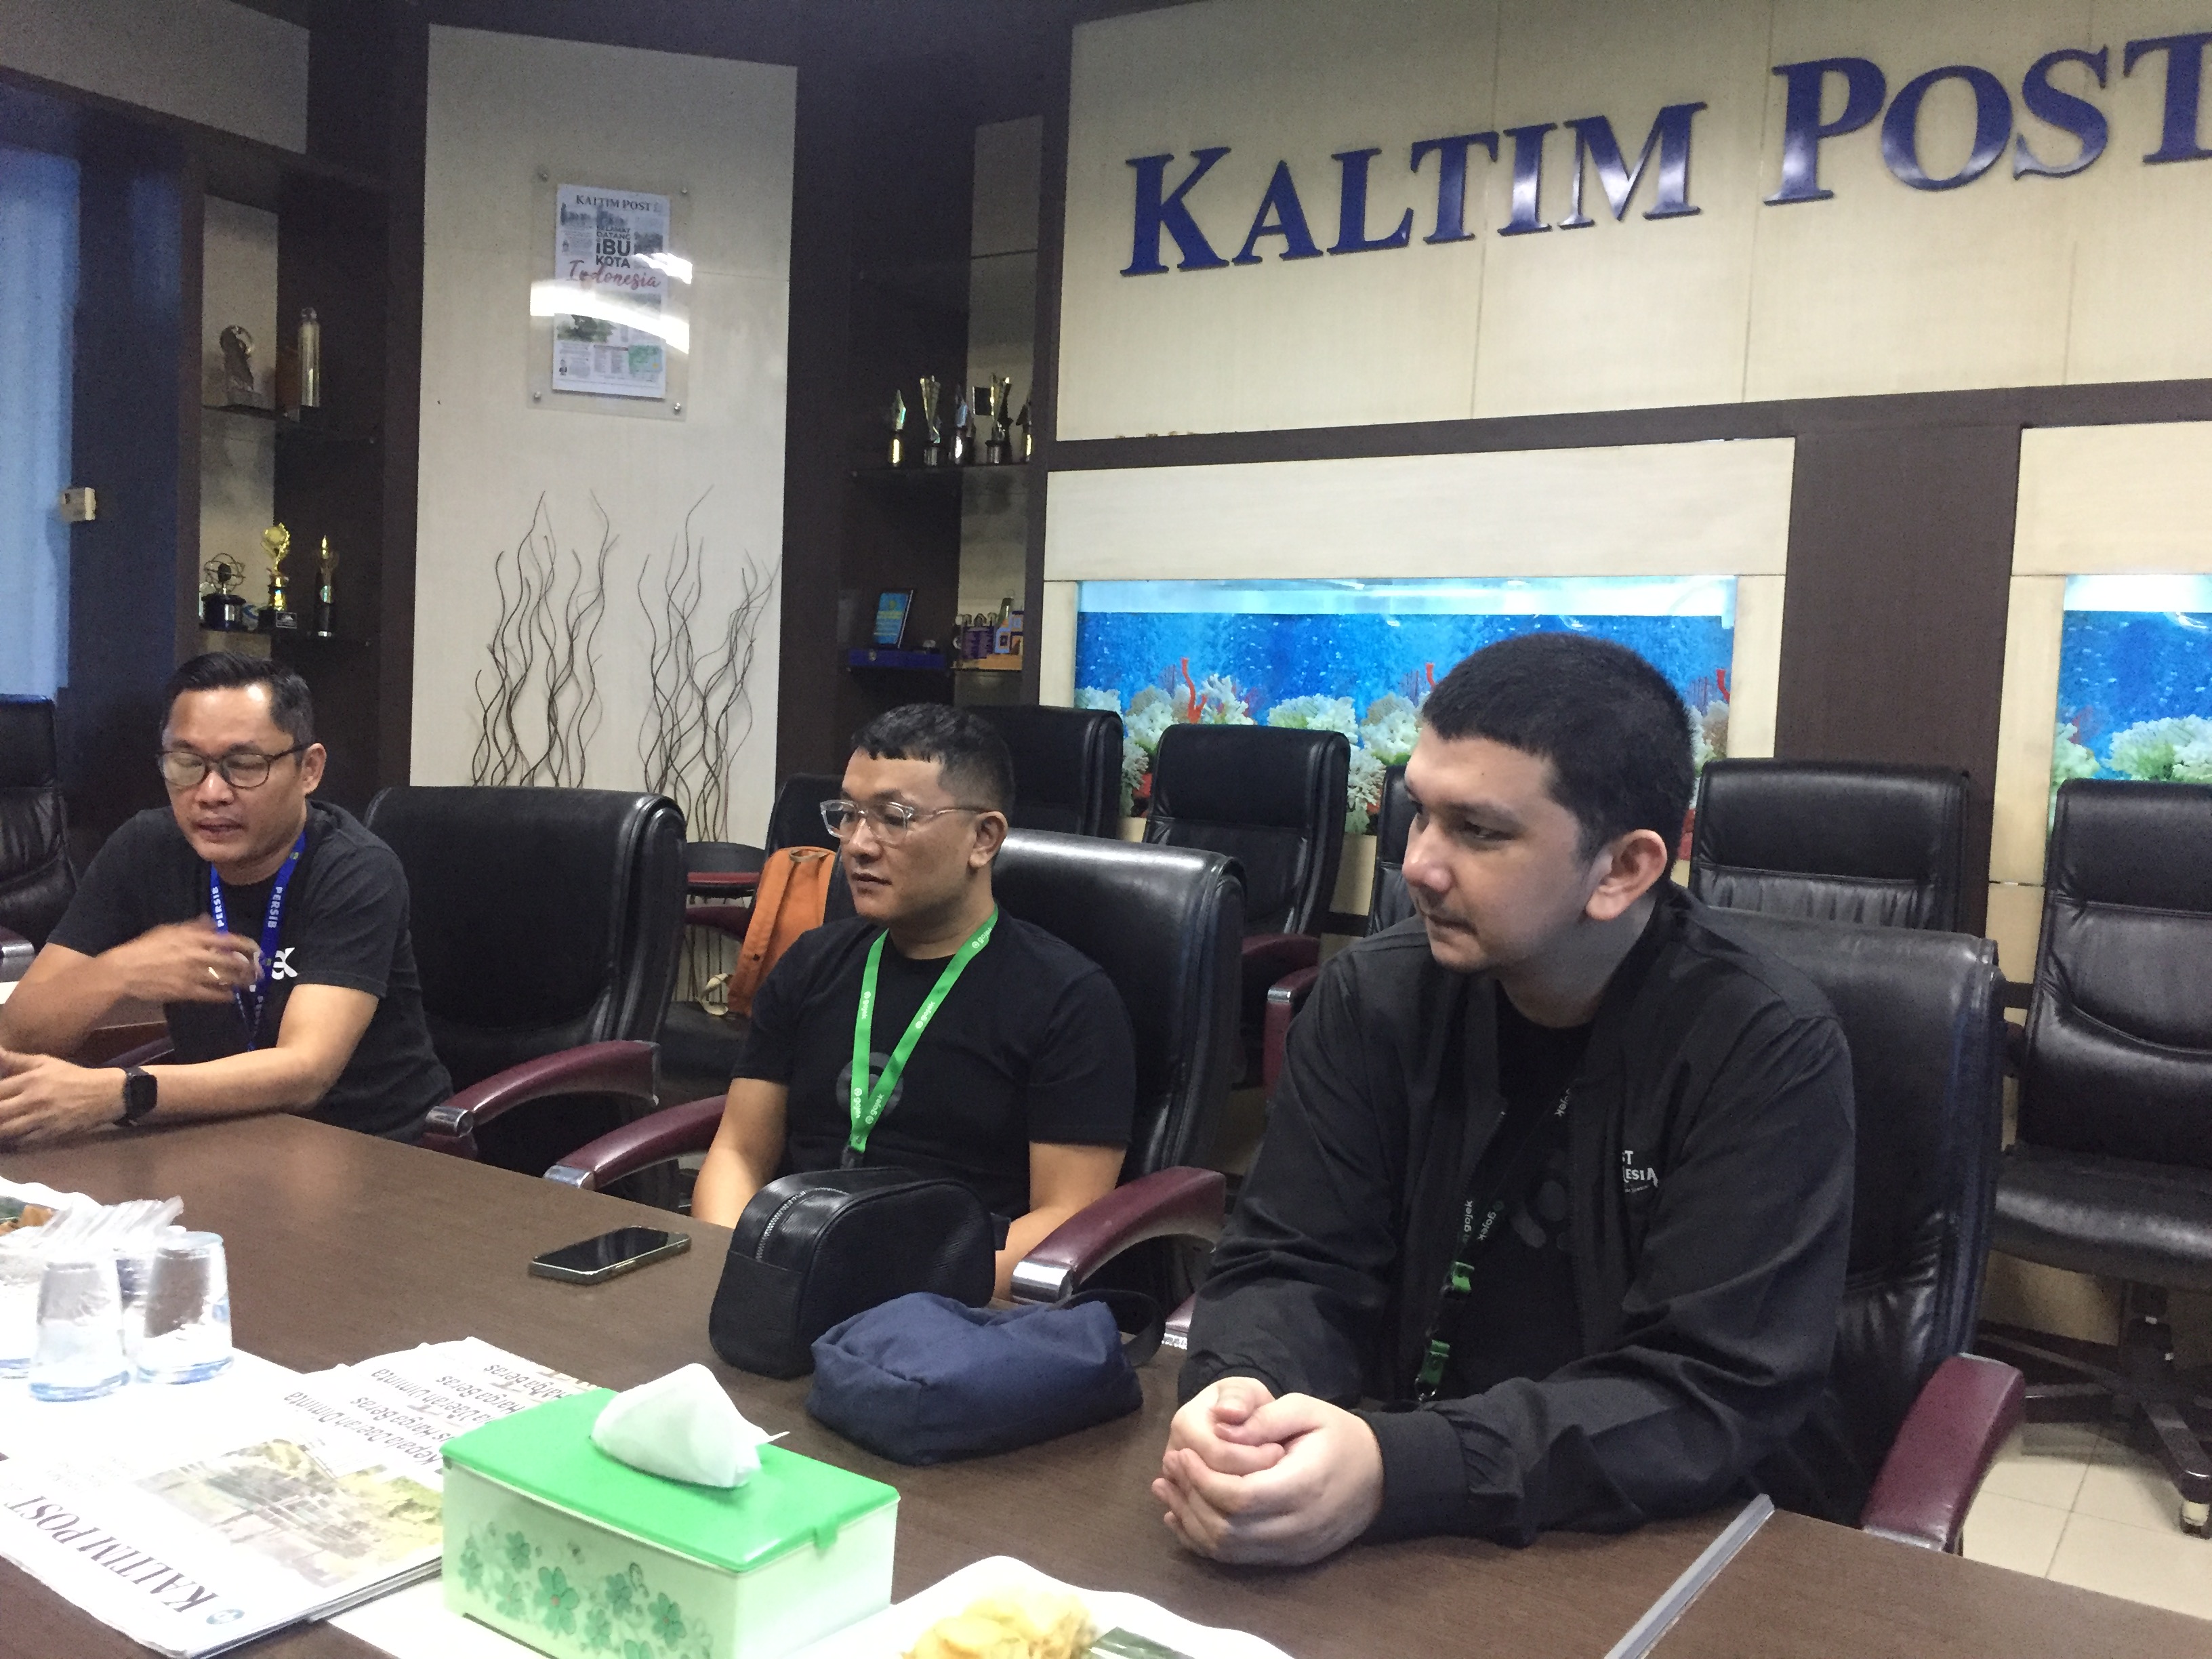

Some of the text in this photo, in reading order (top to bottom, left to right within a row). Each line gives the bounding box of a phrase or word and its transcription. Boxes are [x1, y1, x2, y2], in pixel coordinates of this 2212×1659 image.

[1121, 31, 2212, 278] KALTIM POST
[576, 194, 650, 211] KALTIM POST
[596, 255, 631, 268] KOTA
[212, 886, 224, 928] PERSIB
[268, 886, 283, 928] PERSIB
[870, 1093, 885, 1116] gojek
[1464, 1200, 1473, 1233] gojek
[1477, 1211, 1497, 1241] gojek
[436, 1376, 526, 1415] Harga Beras
[283, 1392, 443, 1465] Kepala Daerah Diminta
[350, 1397, 437, 1436] Harga Beras
[3, 1495, 219, 1613] KALTIM POST
